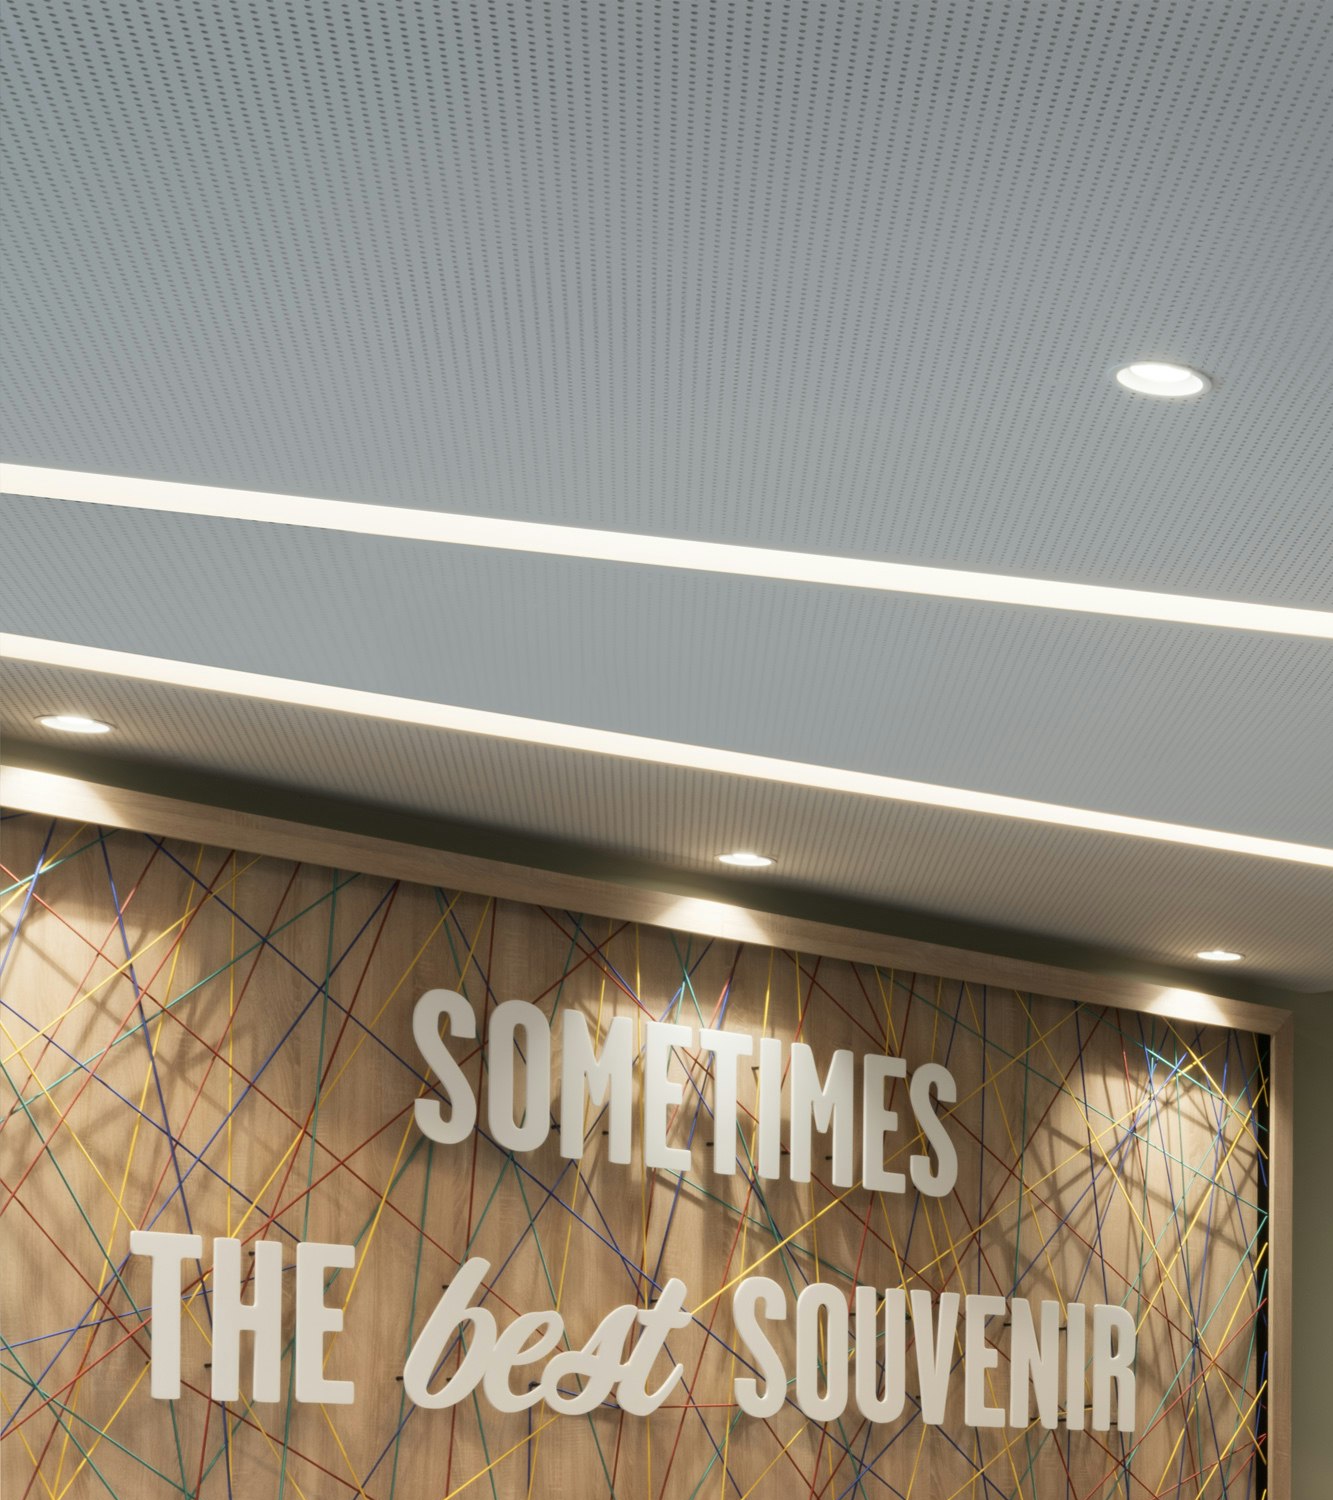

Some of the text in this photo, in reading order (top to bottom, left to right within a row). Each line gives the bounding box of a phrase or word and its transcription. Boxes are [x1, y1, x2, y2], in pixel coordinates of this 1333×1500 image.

[411, 988, 959, 1198] SOMETIMES
[129, 1230, 1137, 1433] THE best SOUVENIR
